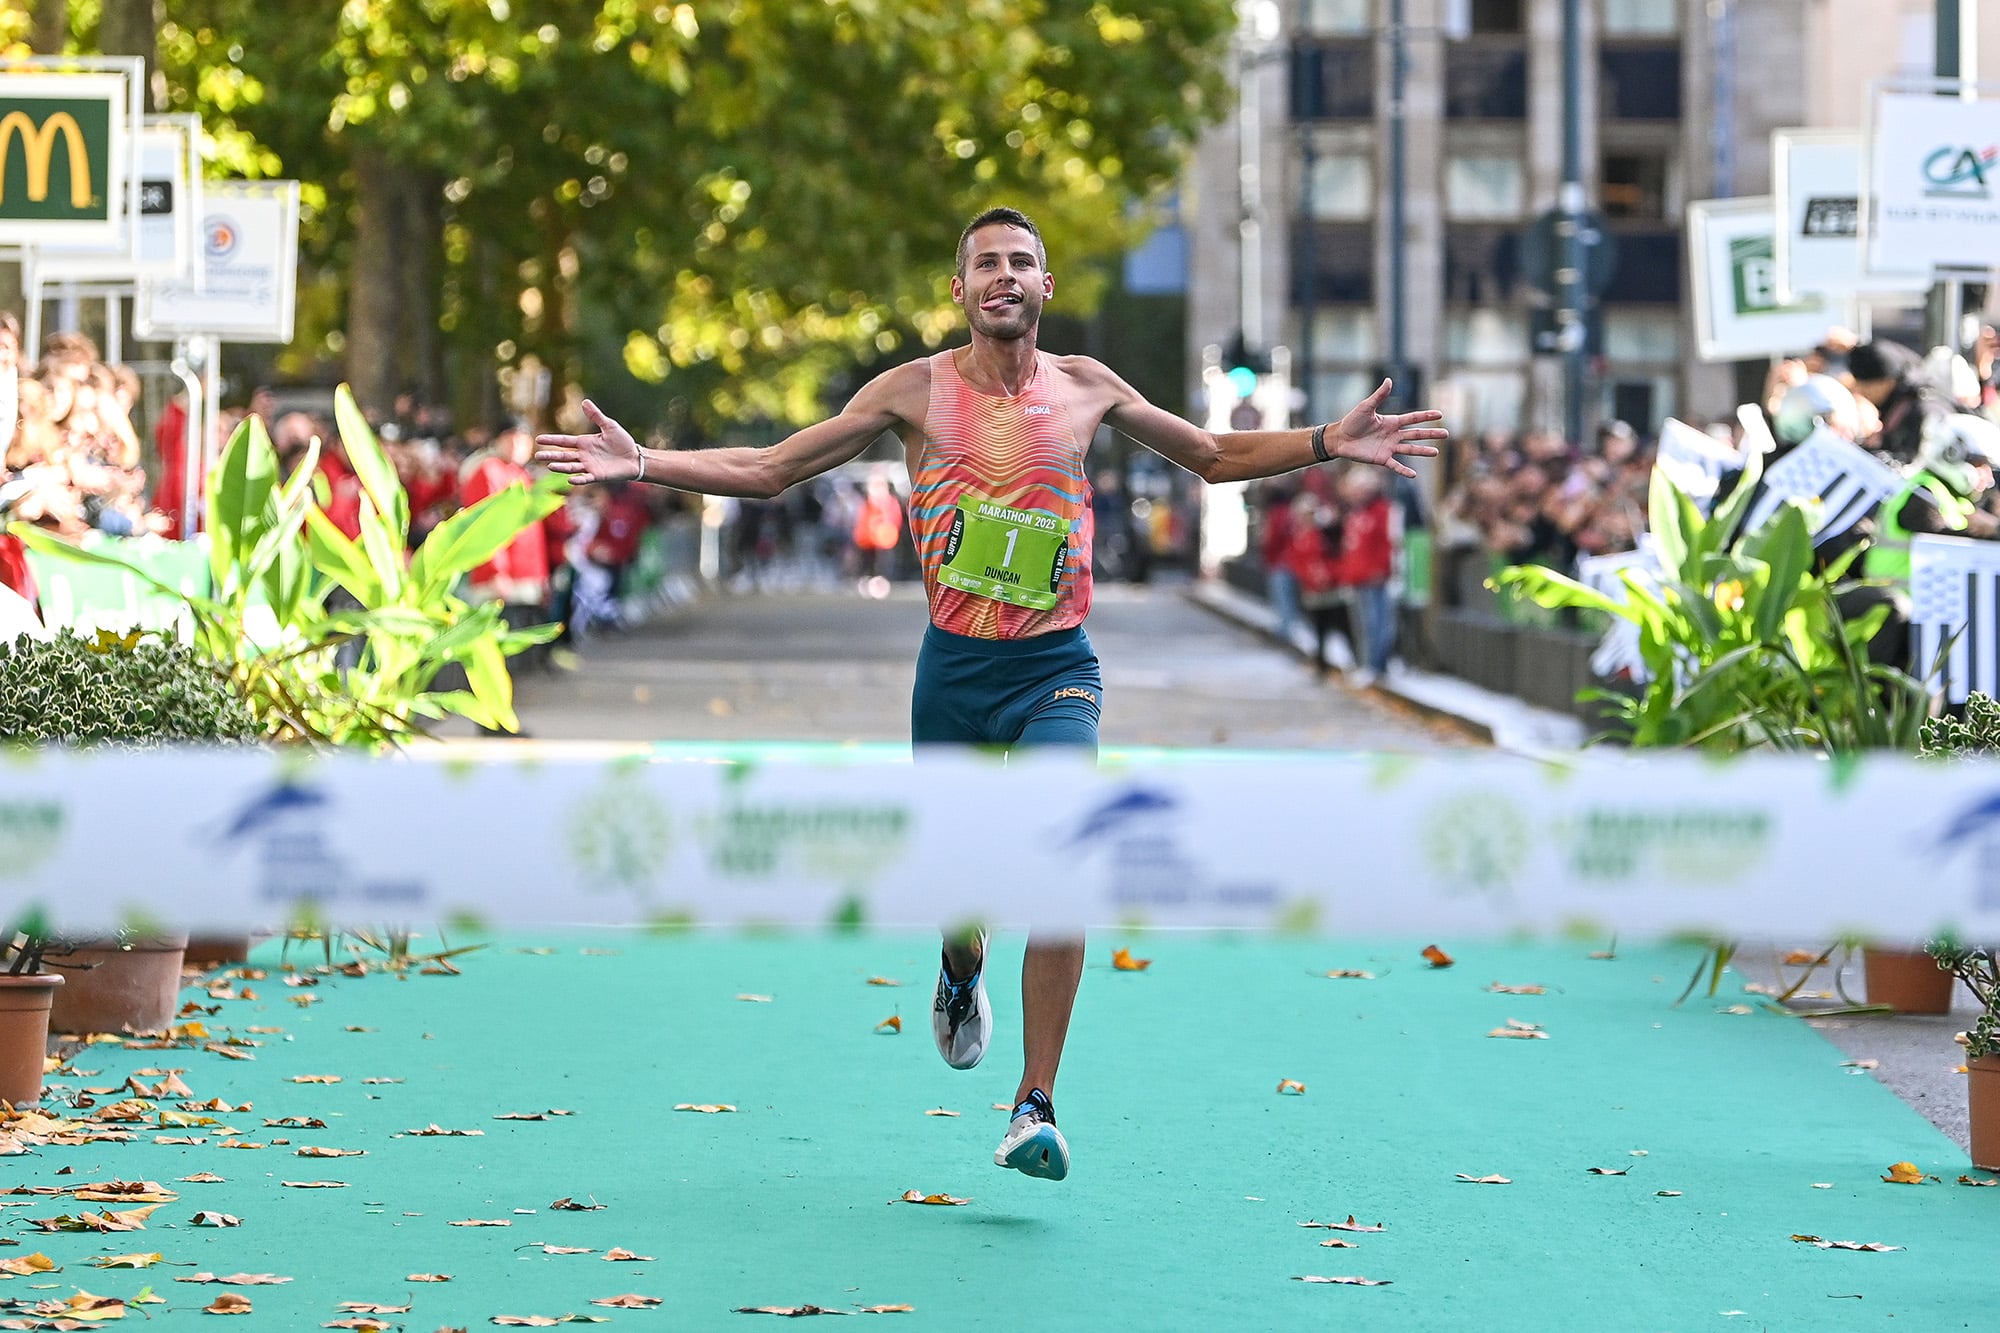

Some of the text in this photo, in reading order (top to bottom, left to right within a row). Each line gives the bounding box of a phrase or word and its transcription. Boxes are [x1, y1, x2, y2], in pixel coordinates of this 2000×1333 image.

[1024, 405, 1050, 415] HOKA
[978, 503, 1056, 529] MARATHON 2025
[948, 537, 958, 555] SUPER
[1003, 529, 1018, 567] 1
[1057, 547, 1067, 568] SUPER
[985, 566, 1021, 584] DUNCAN
[1054, 687, 1096, 703] HOKA
